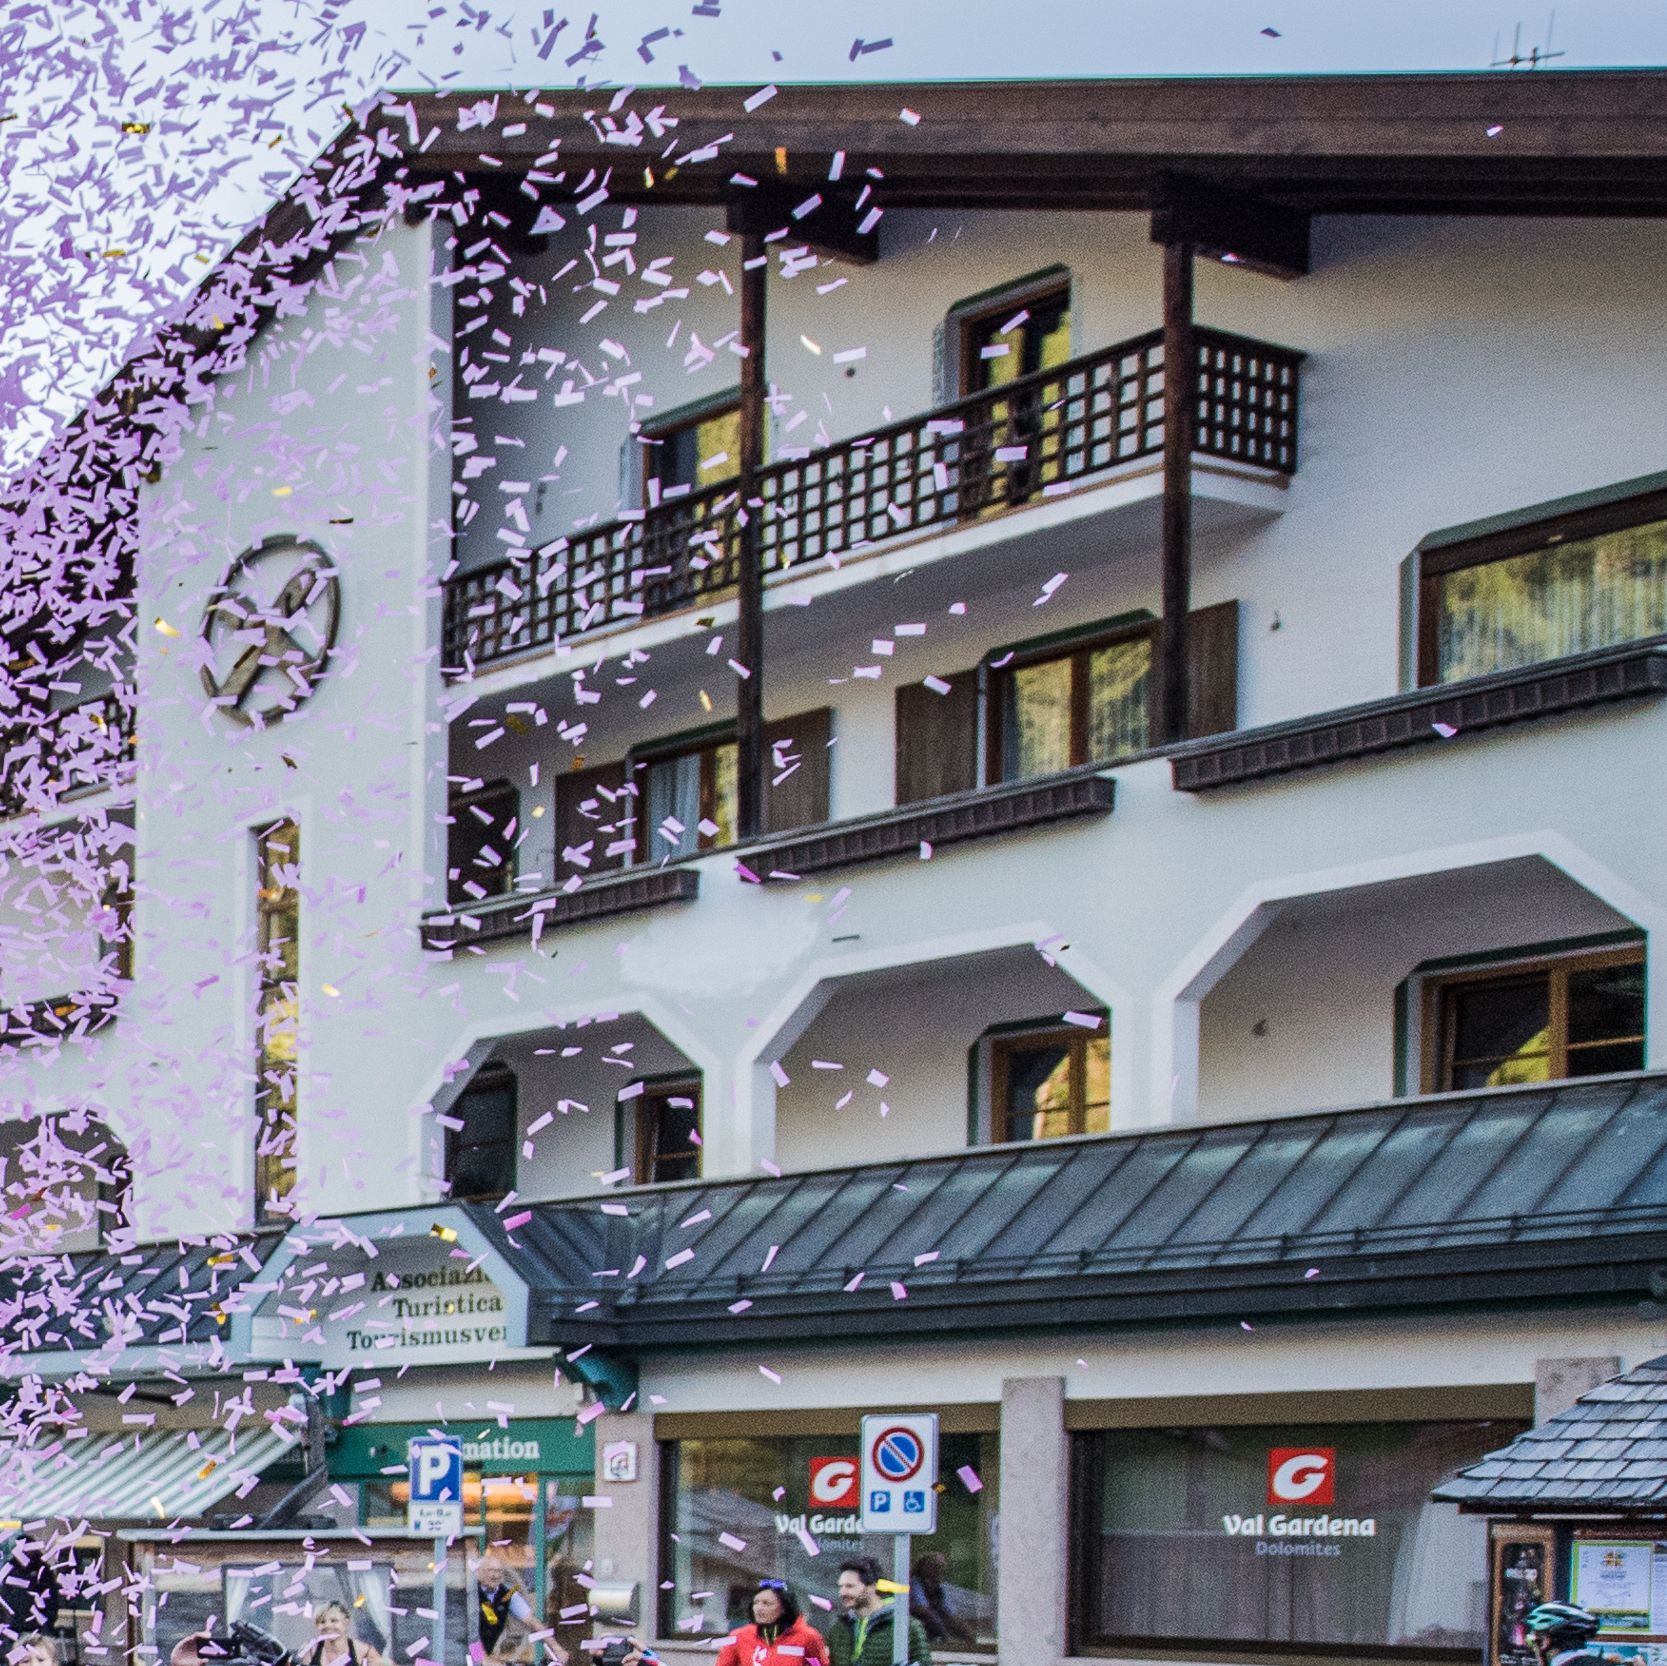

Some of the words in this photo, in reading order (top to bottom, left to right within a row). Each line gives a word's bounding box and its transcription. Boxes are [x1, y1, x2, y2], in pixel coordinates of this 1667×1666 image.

[393, 1294, 504, 1318] Turistica
[463, 1438, 541, 1461] mation
[775, 1513, 807, 1534] Val
[1223, 1514, 1264, 1537] Val
[1268, 1514, 1376, 1537] Gardena
[1255, 1540, 1342, 1557] Dolomites
